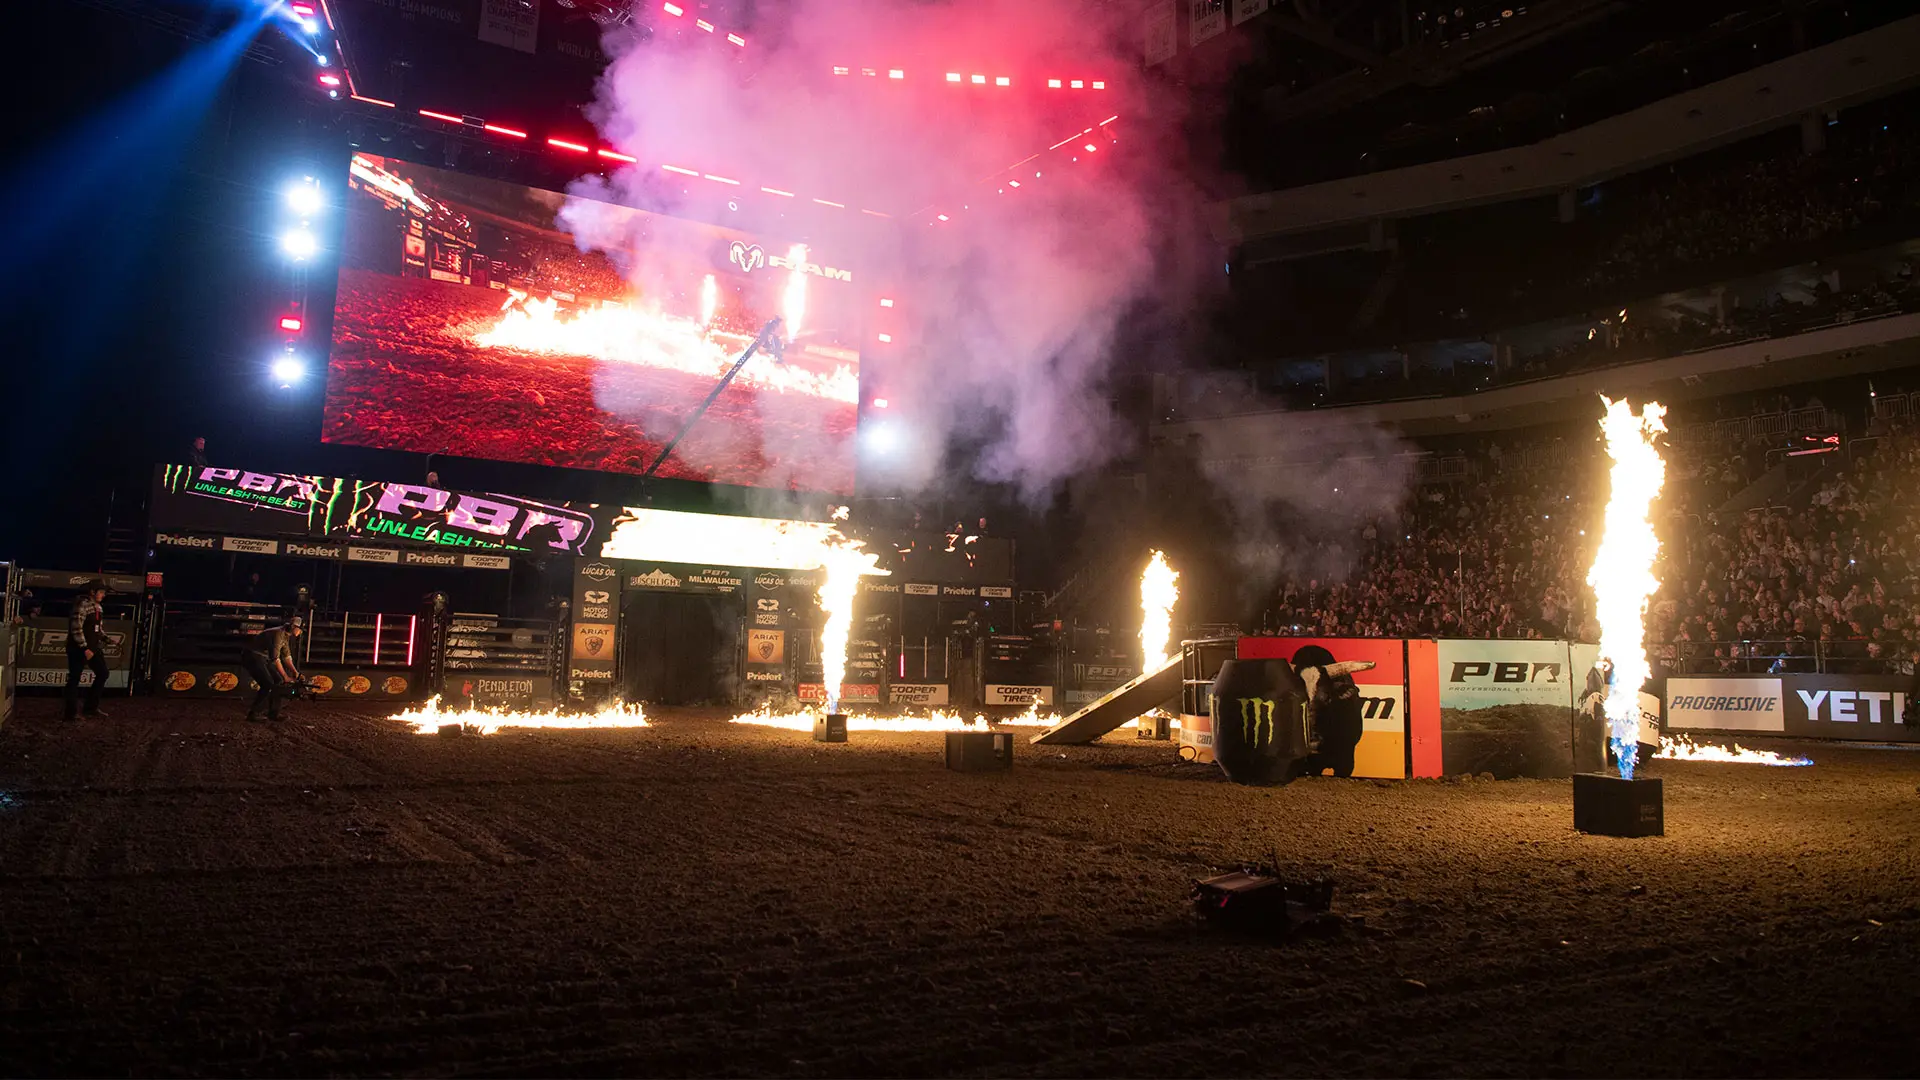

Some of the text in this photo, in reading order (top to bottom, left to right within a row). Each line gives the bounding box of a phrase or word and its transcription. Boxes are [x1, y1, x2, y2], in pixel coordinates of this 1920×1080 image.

[199, 467, 315, 499] PBR
[194, 482, 306, 509] UNLEASH THE BEAST
[375, 482, 586, 551] PBR
[365, 516, 473, 547] UNLEASH
[155, 533, 214, 548] Priefert
[231, 539, 270, 547] COOPER
[286, 543, 340, 557] Priefert
[406, 551, 457, 565] Priefert
[581, 566, 616, 577] LUCAS OIL
[688, 575, 742, 586] MILWAUKEE
[754, 576, 784, 586] LUCAS OIL
[864, 582, 900, 593] Priefert
[943, 586, 976, 596] Priefert
[580, 628, 609, 636] ARIAT
[753, 633, 780, 641] ARIAT
[19, 671, 63, 684] BUSCH
[571, 668, 612, 679] Priefert
[747, 671, 782, 681] Priefert
[1450, 661, 1561, 683] PBR
[478, 679, 533, 693] PENDLETON
[889, 686, 937, 694] COOPER
[997, 687, 1042, 695] COOPER
[895, 694, 930, 702] TIRES
[1670, 695, 1777, 712] PROGRESSIVE
[1796, 689, 1906, 725] YETI
